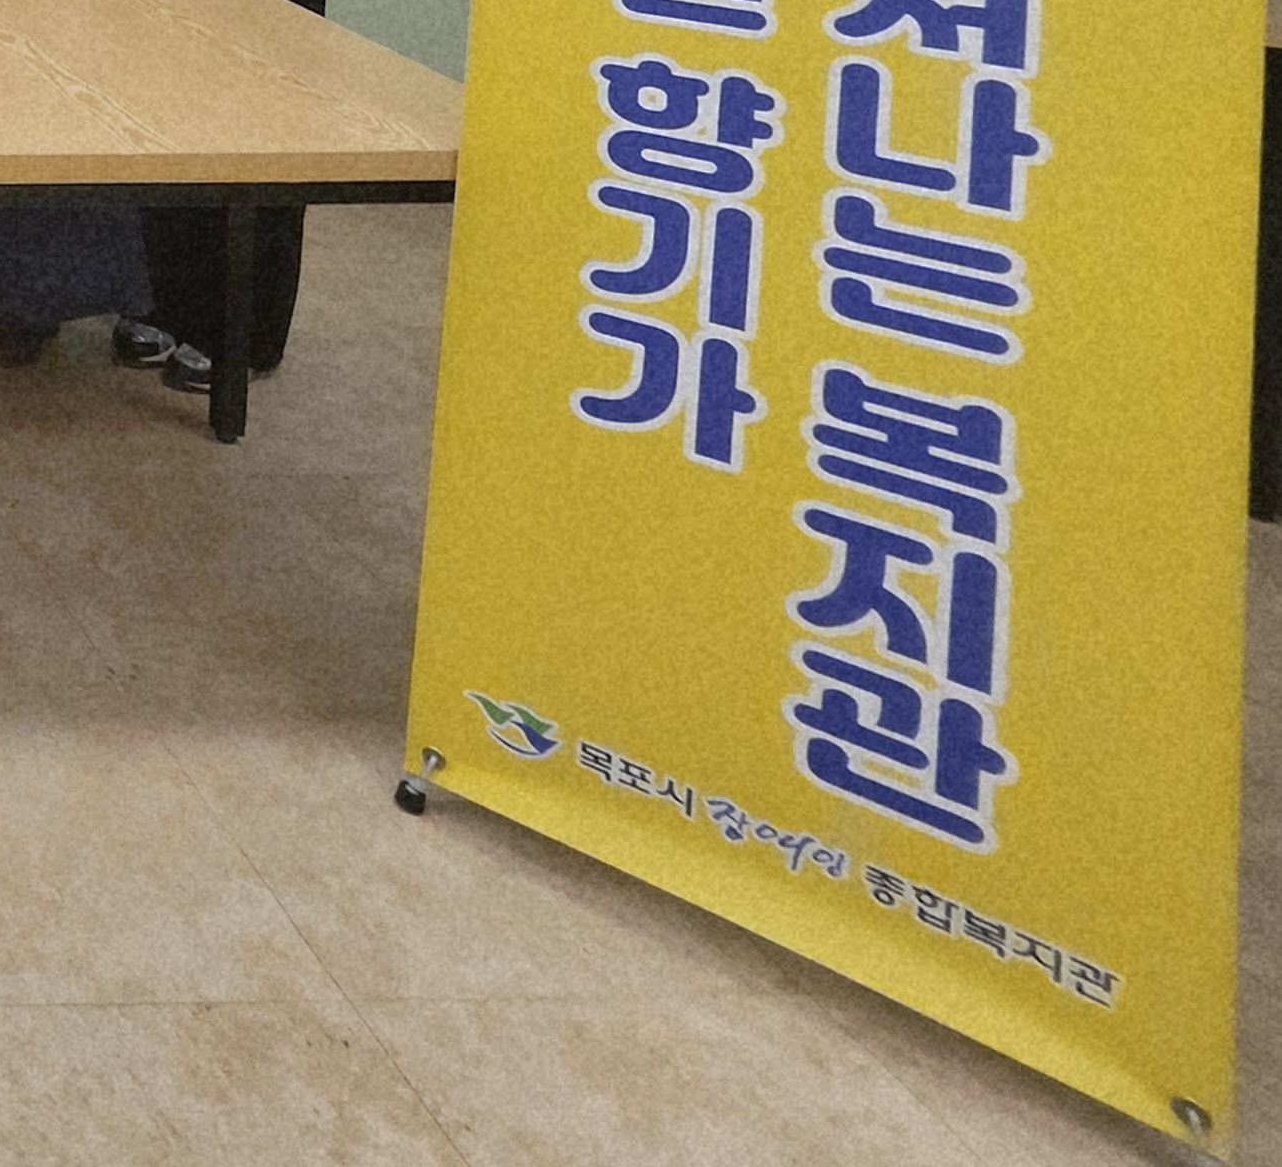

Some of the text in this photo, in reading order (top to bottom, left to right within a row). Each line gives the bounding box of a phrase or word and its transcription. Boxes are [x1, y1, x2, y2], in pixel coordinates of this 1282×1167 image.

[575, 60, 779, 468] 향기가
[789, 366, 1013, 845] 복지관
[576, 742, 1120, 1007] 목포시 장애인 종합복지관
